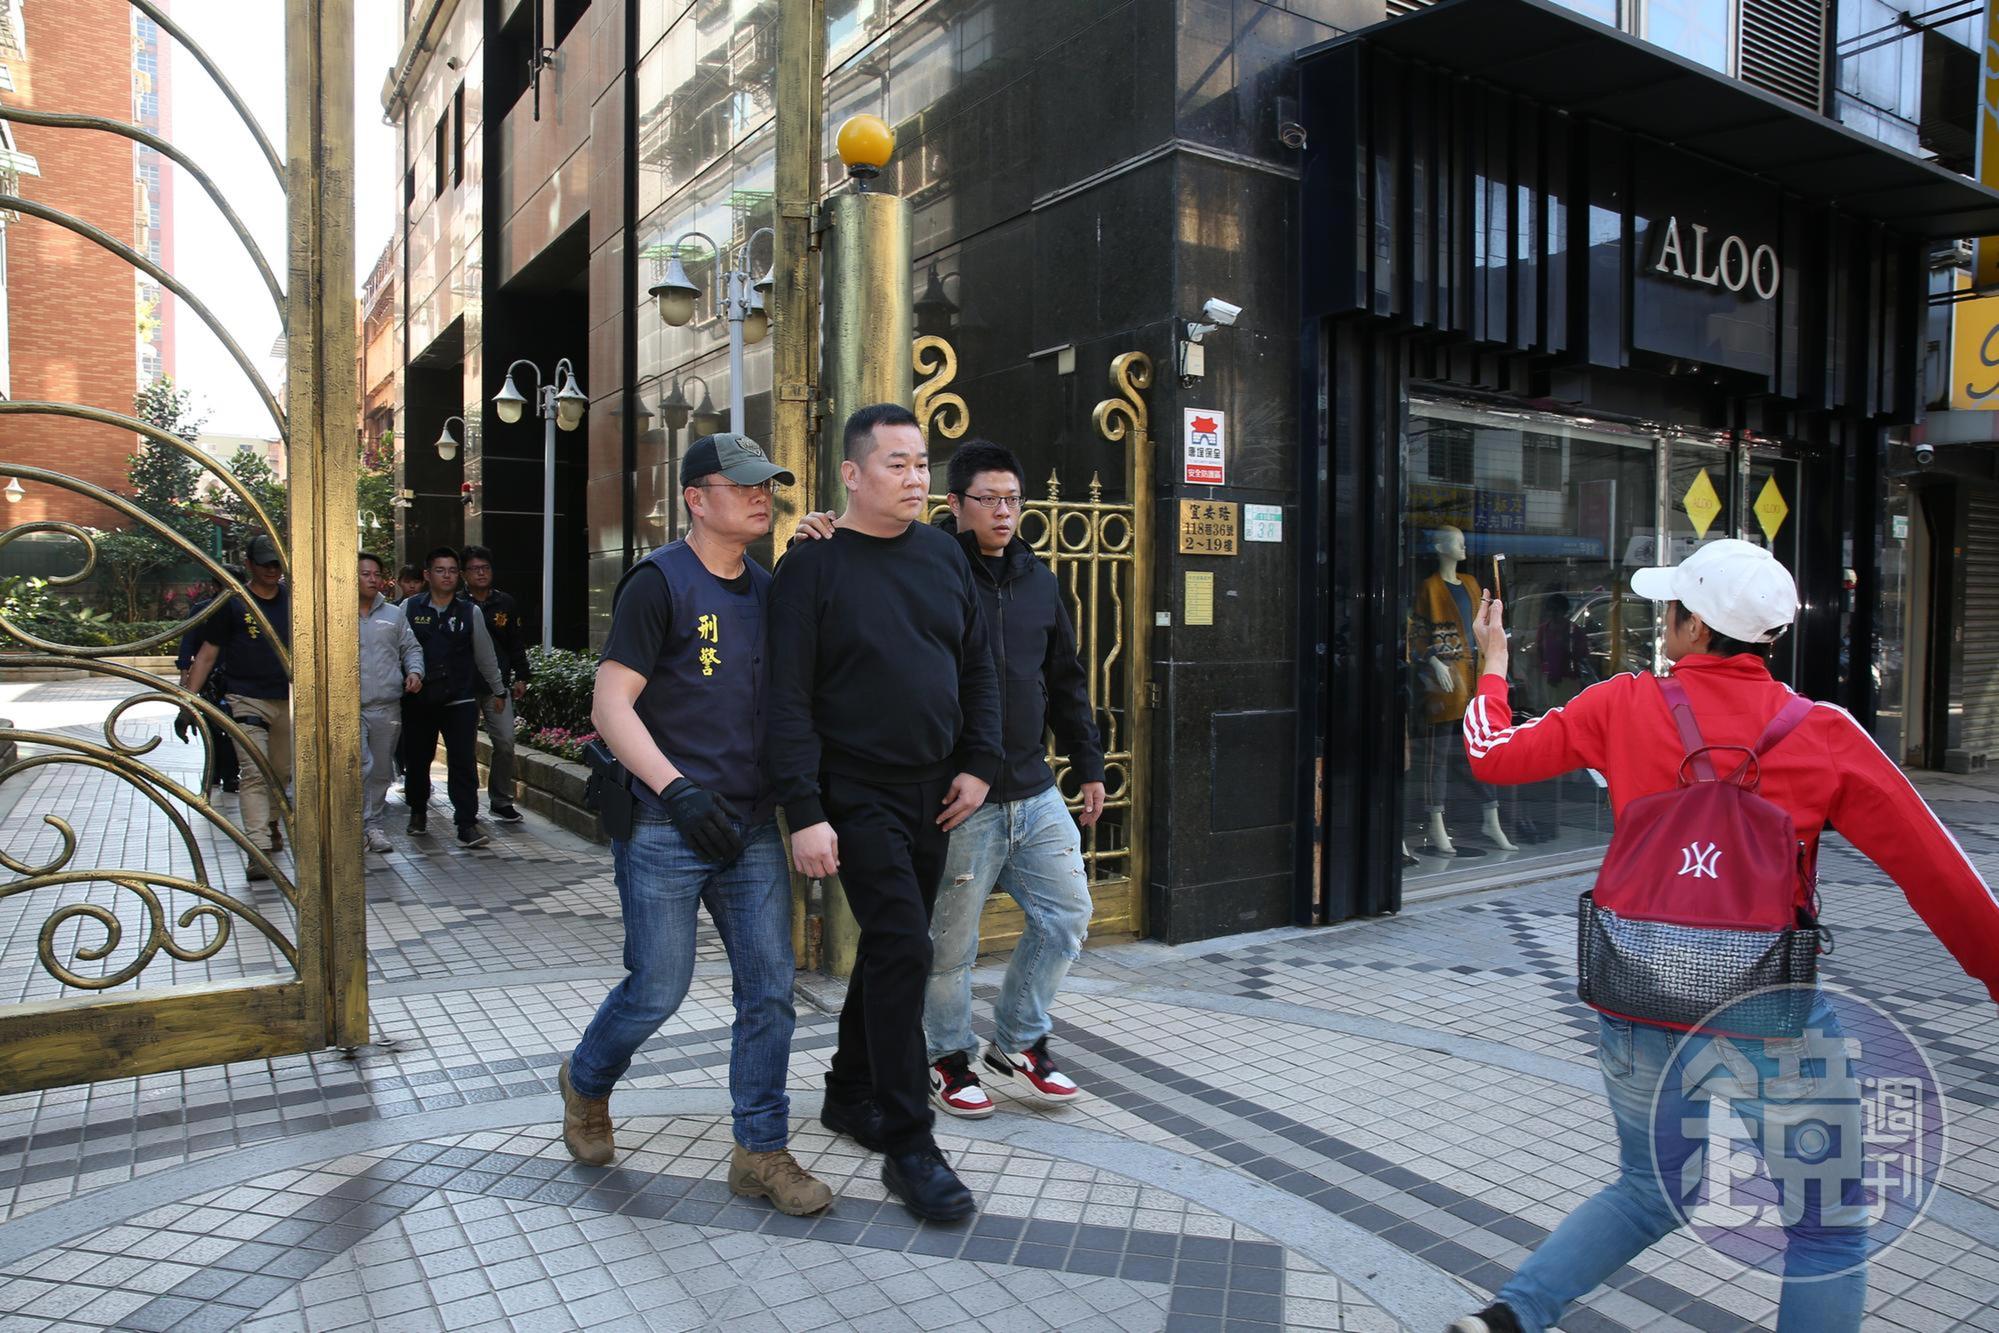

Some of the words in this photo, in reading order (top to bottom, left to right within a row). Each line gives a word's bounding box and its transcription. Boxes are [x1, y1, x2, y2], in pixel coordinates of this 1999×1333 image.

[1655, 216, 1780, 300] ALOO
[1185, 522, 1234, 536] 118巷36號
[697, 614, 721, 676] 刑警
[1677, 841, 1722, 879] NY
